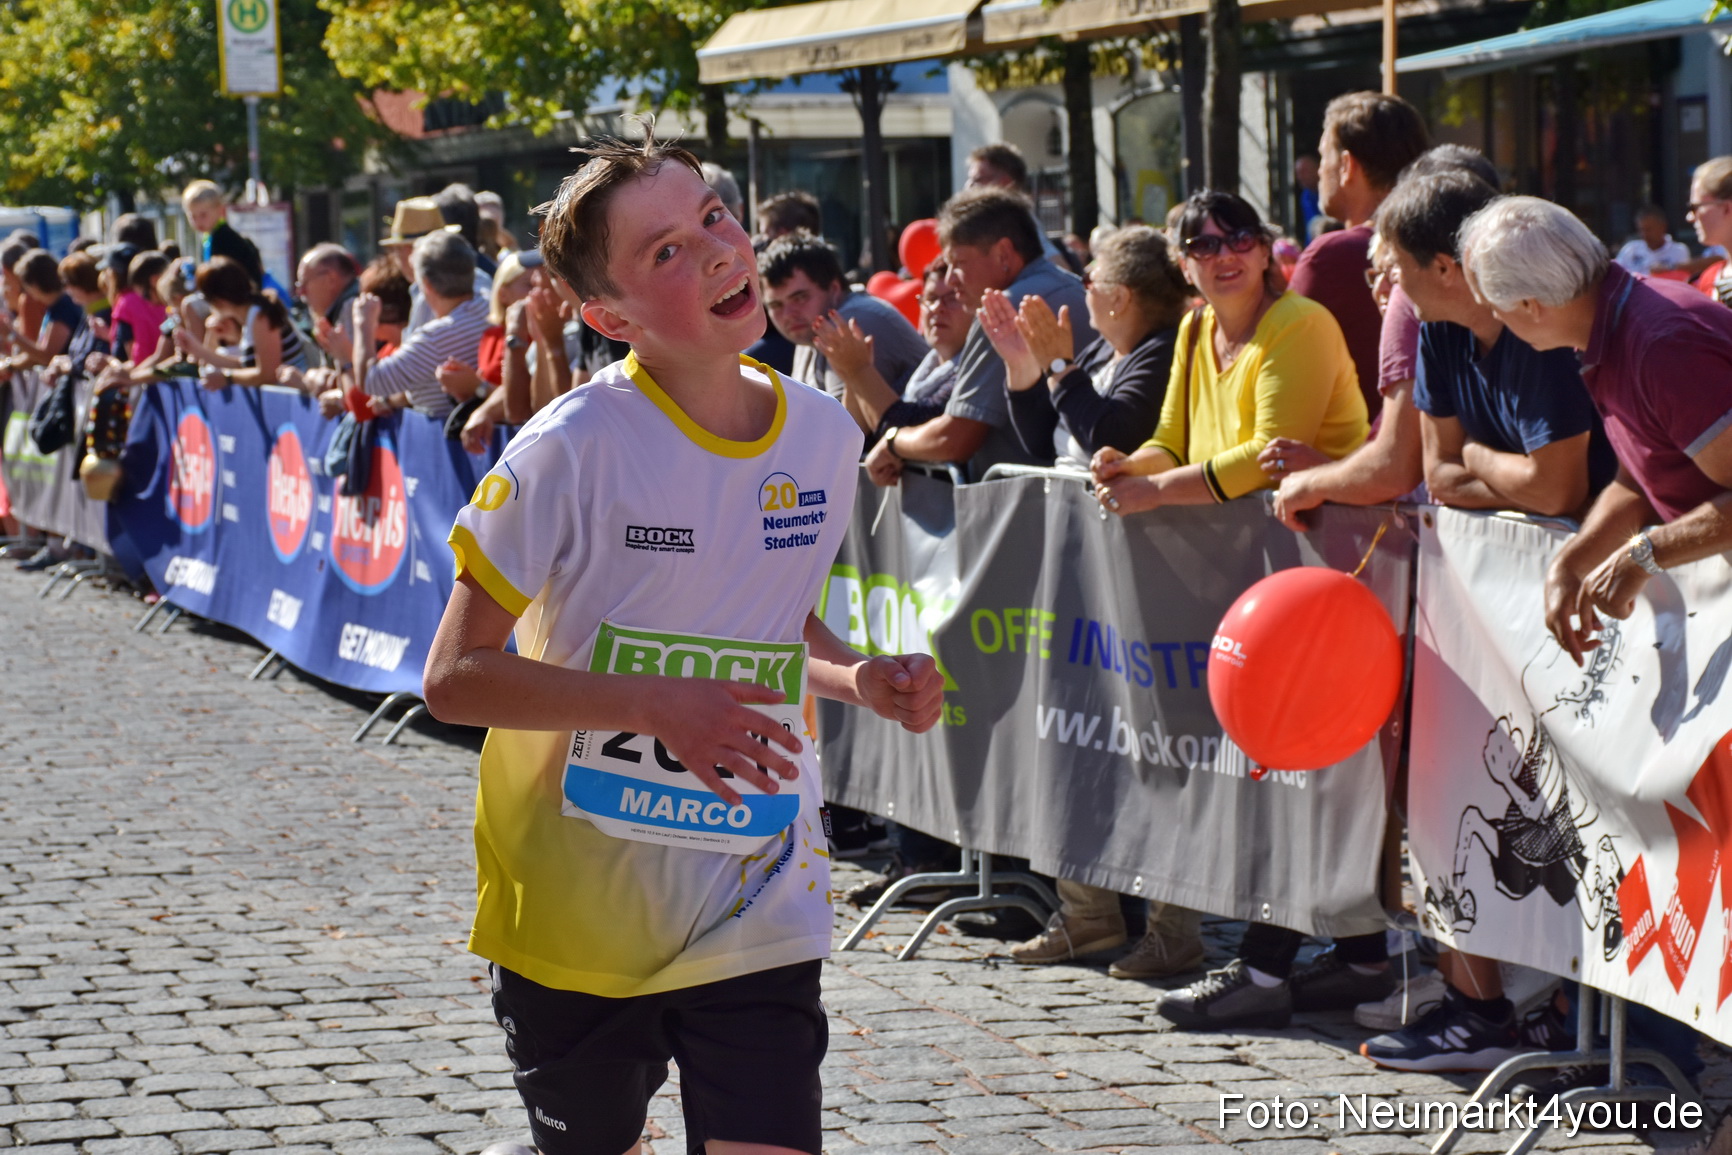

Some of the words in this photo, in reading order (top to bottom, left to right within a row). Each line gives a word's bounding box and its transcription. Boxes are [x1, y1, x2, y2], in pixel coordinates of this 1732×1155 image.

[764, 482, 796, 511] 20
[801, 492, 823, 506] JAHRE
[626, 525, 694, 547] BOCK
[650, 544, 658, 552] by
[764, 529, 820, 551] Stadtlau
[607, 636, 795, 692] BOCK
[619, 786, 752, 829] MARCO
[535, 1106, 567, 1131] Marco
